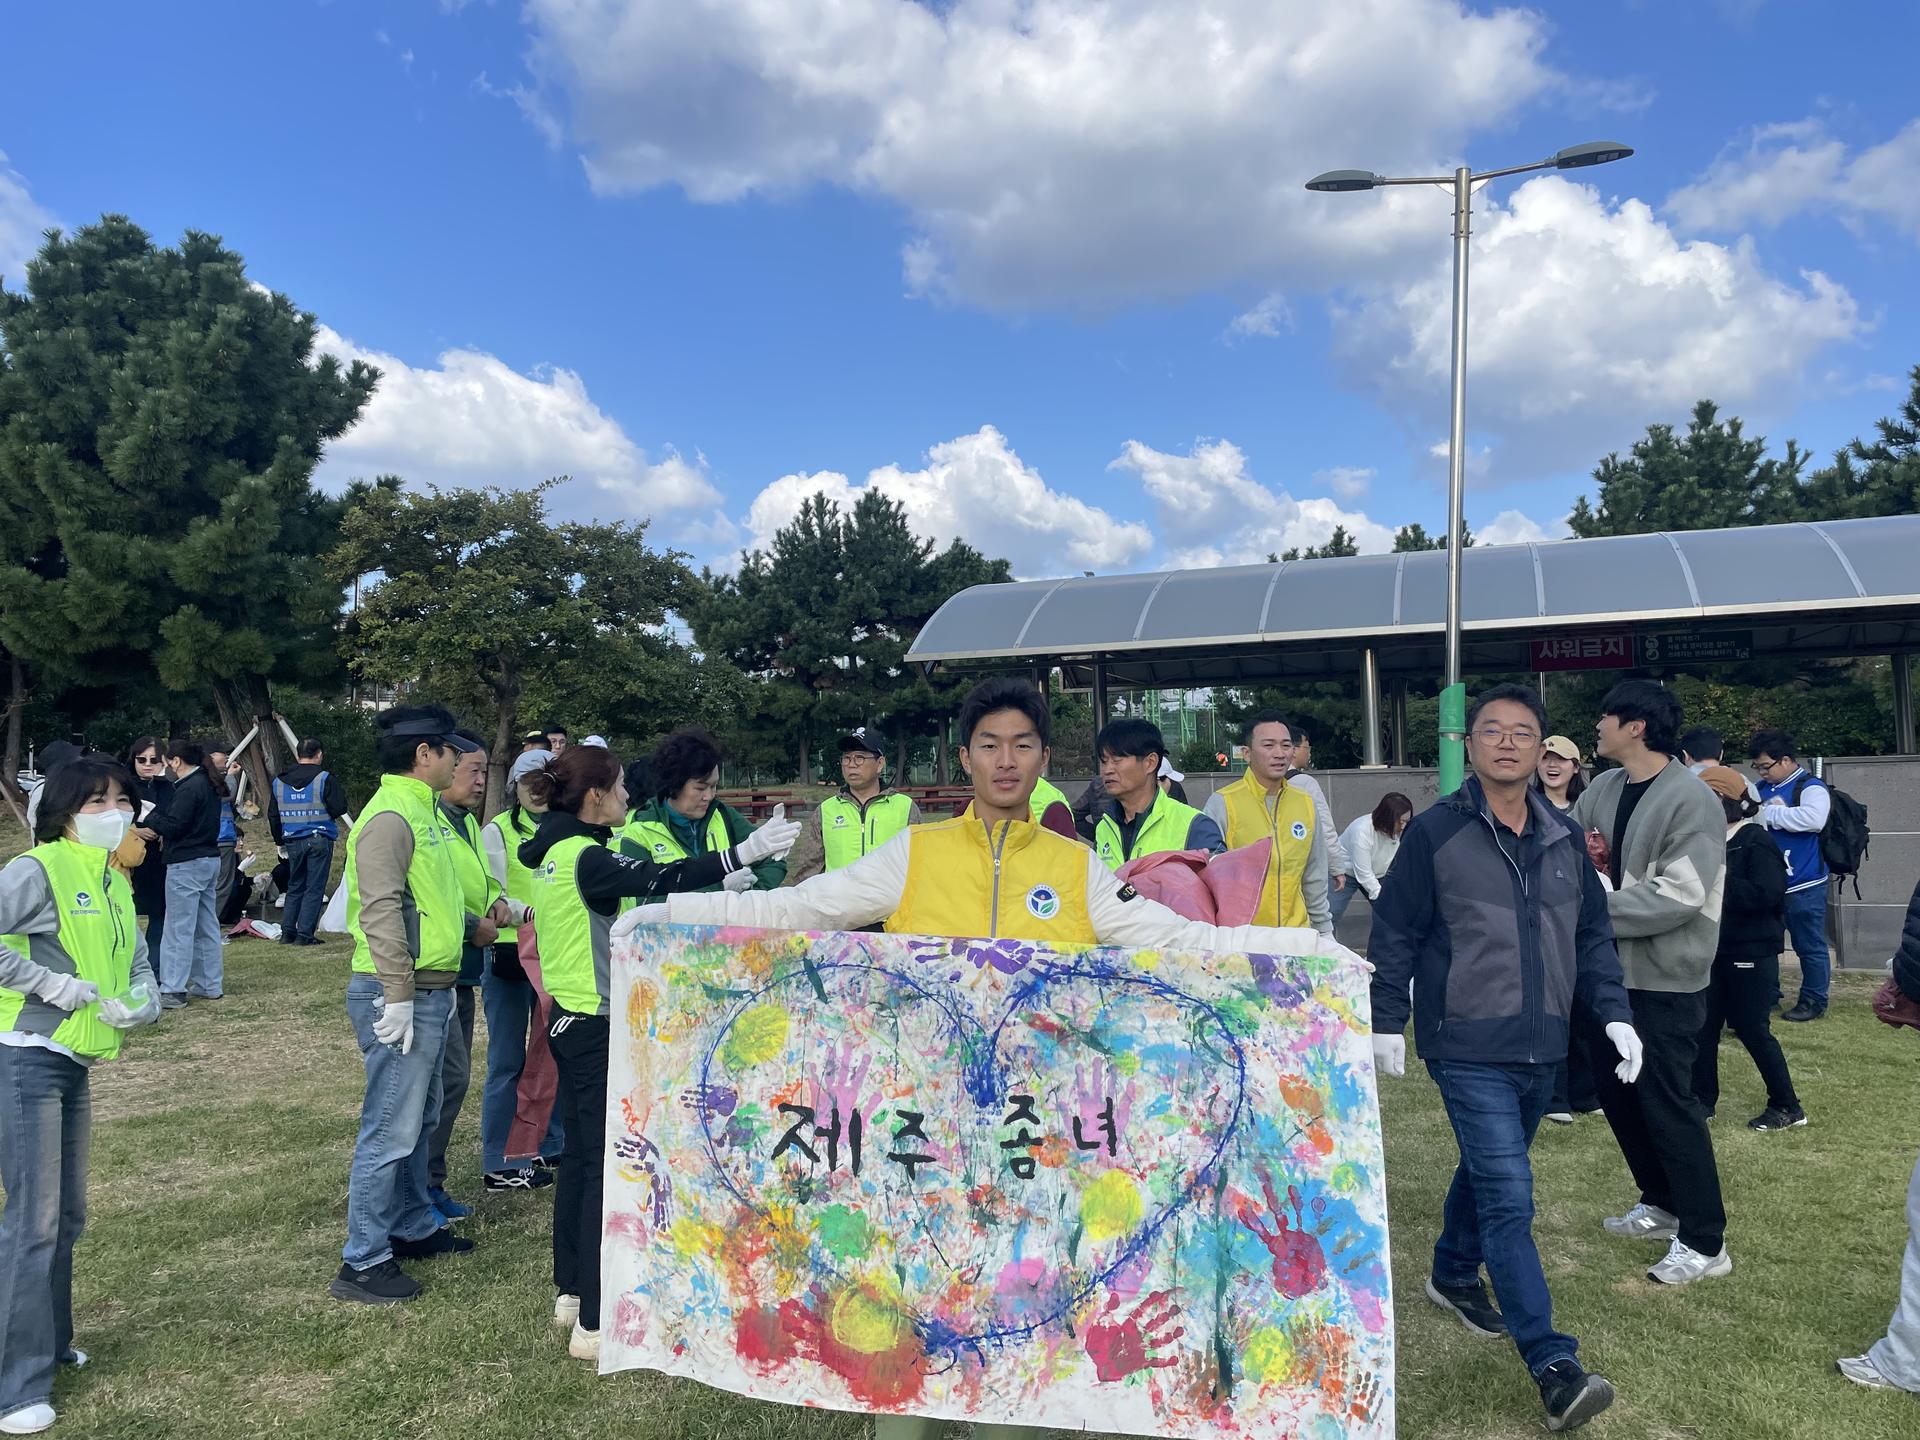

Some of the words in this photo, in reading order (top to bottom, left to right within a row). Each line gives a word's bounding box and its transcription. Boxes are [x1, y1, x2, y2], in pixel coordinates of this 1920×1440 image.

[1538, 636, 1625, 659] 샤워금지
[771, 1102, 937, 1180] 제주
[1638, 1217, 1657, 1229] N
